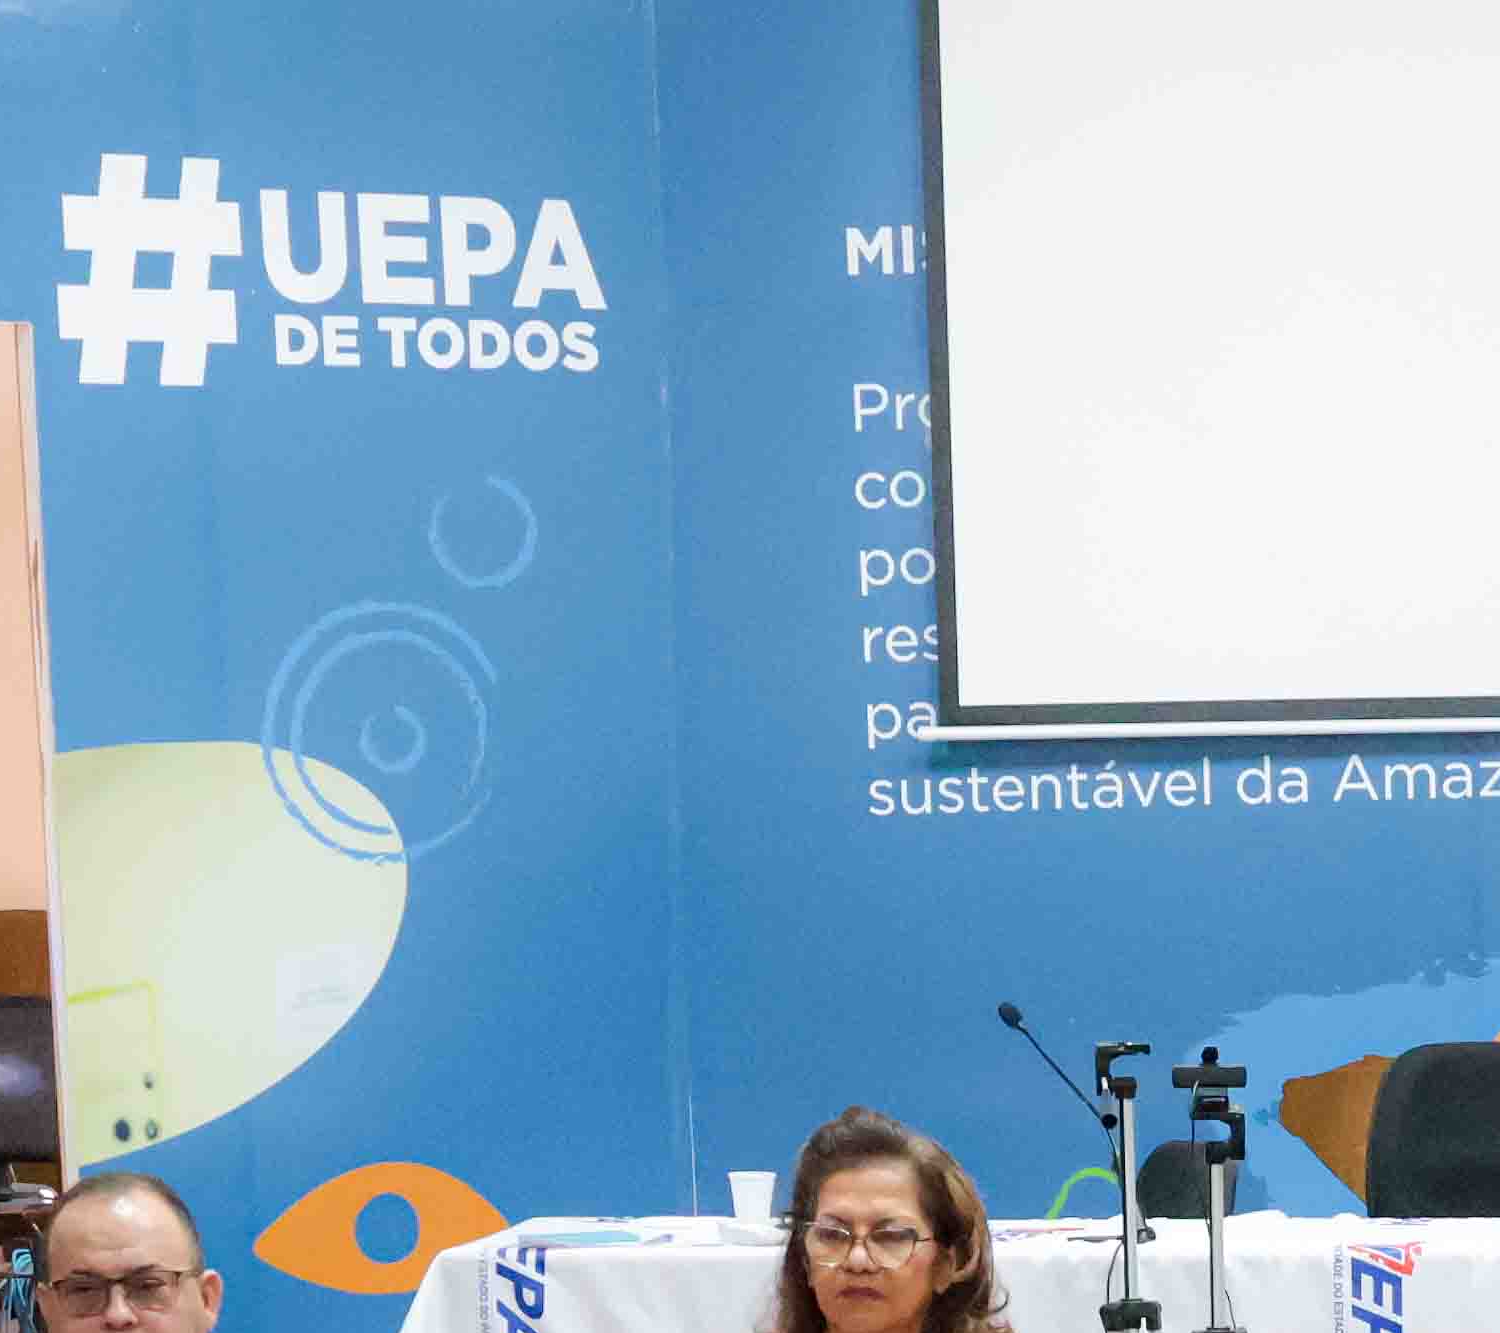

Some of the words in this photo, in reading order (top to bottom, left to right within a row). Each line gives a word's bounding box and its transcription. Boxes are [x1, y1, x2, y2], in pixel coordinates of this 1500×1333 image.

[845, 224, 927, 276] MI
[274, 313, 361, 367] DE
[376, 316, 600, 372] TODOS
[869, 758, 1212, 816] sustentável
[1236, 756, 1309, 805] da
